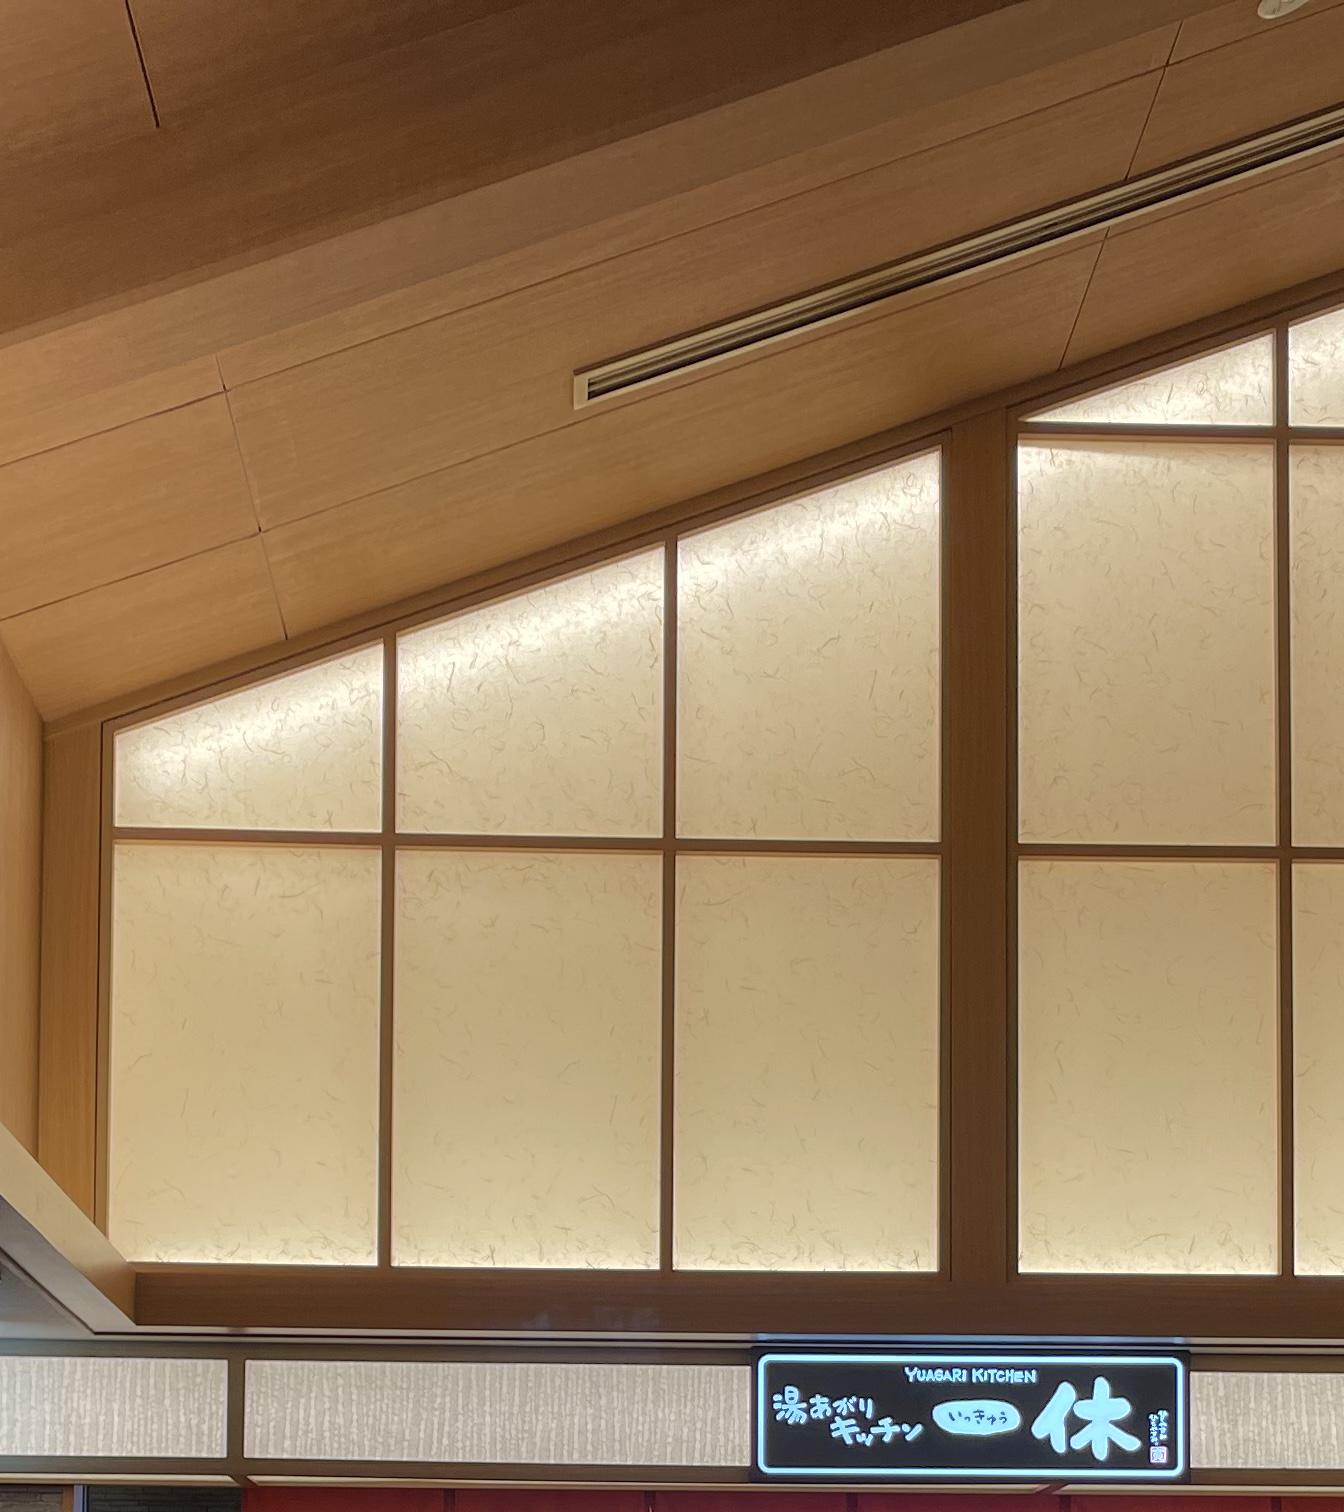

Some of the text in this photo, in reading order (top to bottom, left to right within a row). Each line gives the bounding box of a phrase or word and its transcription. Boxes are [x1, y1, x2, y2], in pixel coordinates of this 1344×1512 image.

[904, 1367, 1036, 1384] YUAGARI KITCHEN
[773, 1385, 874, 1425] 湯あがり
[949, 1407, 1009, 1426] いっきゅう
[830, 1417, 924, 1447] キッチン
